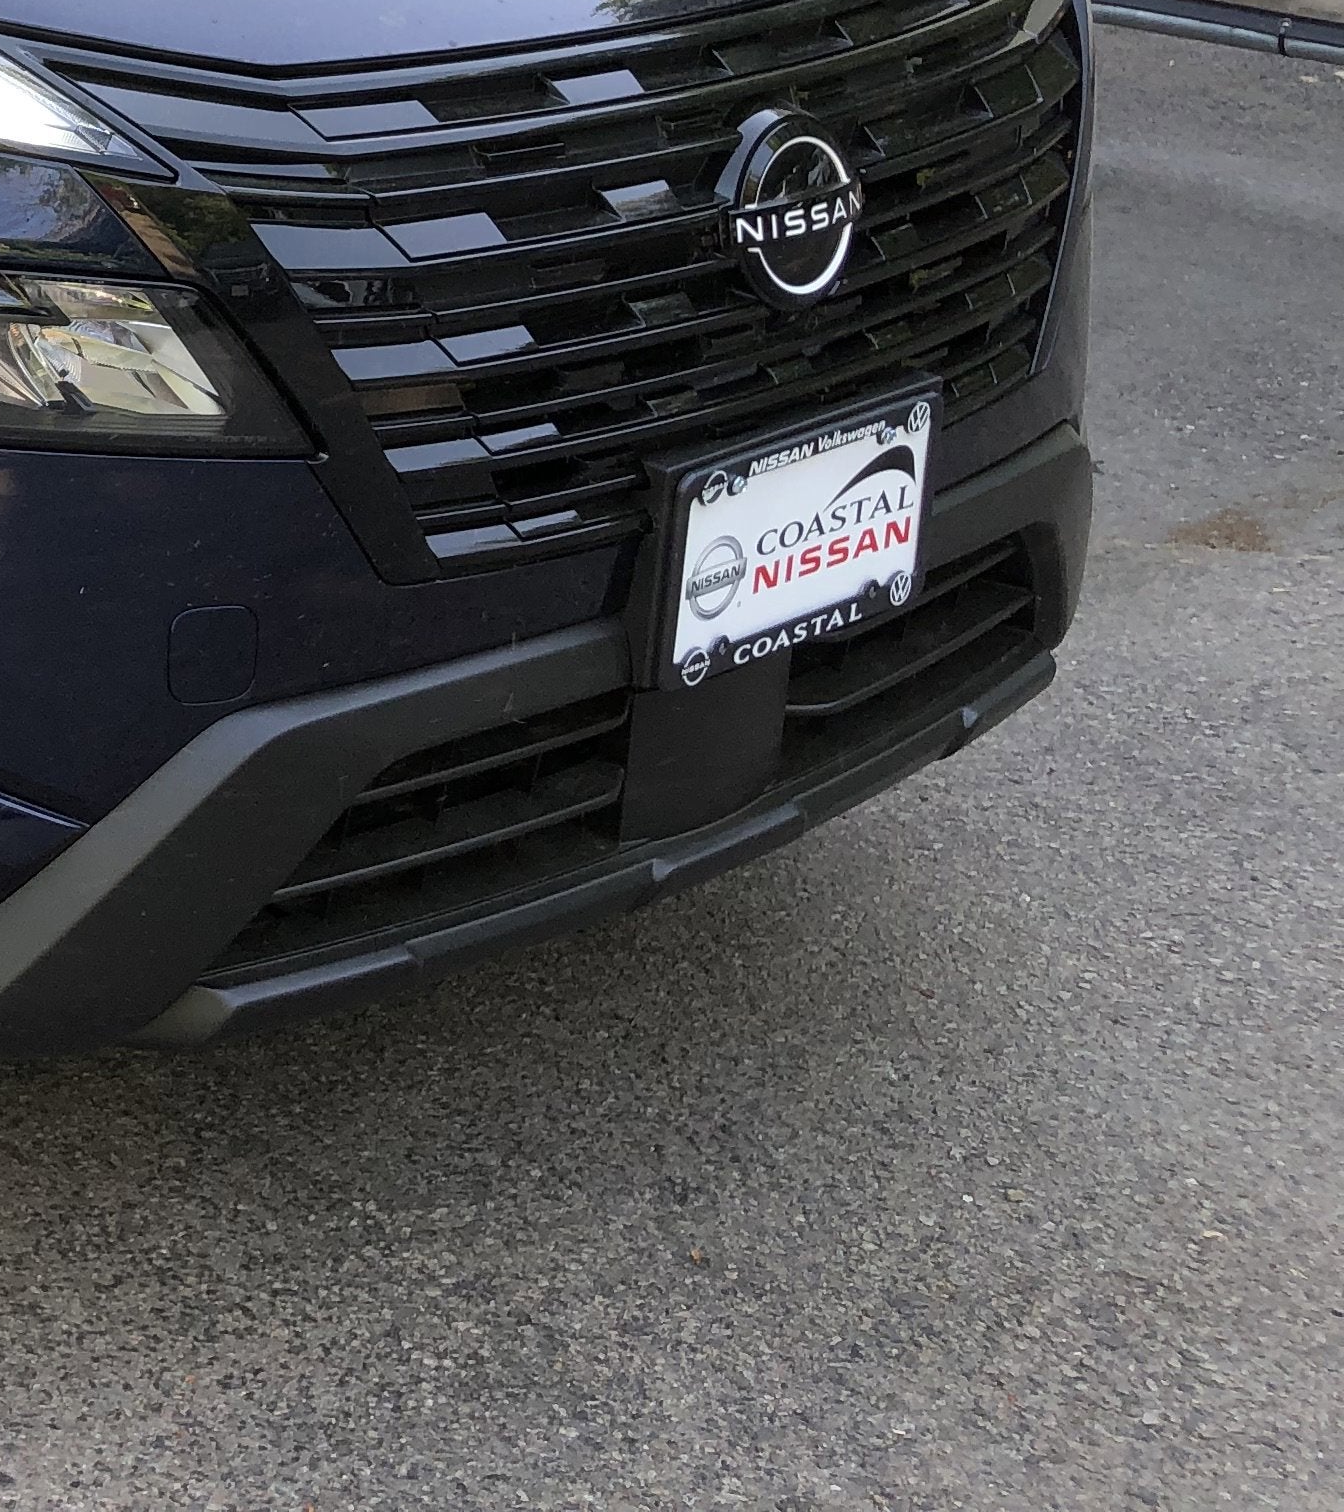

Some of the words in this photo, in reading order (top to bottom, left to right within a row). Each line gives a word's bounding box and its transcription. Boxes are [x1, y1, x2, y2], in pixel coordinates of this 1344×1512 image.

[735, 190, 861, 243] NISSAN
[749, 441, 813, 477] NISSAN
[817, 420, 887, 454] Volkswagen
[755, 484, 914, 556] COASTAL
[690, 562, 742, 594] NISSAN
[752, 516, 912, 595] NISSAN
[732, 602, 863, 666] COASTAL
